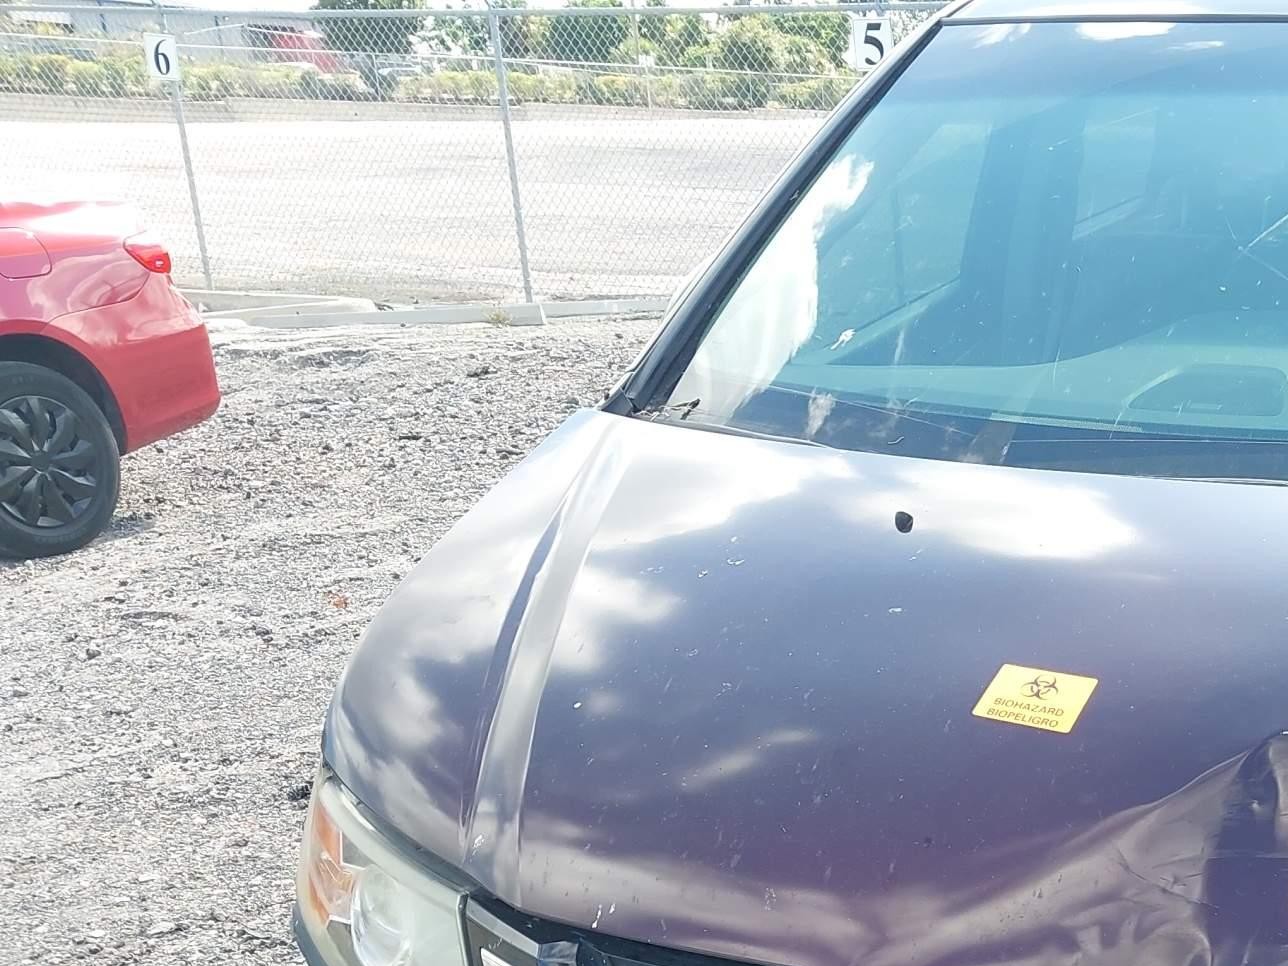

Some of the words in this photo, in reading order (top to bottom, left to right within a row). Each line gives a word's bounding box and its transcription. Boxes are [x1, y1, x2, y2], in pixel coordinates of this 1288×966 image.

[154, 38, 171, 76] 6
[863, 22, 885, 66] 5
[986, 708, 1059, 727] BIOPELIGRO
[994, 697, 1064, 716] BIOHAZARD
